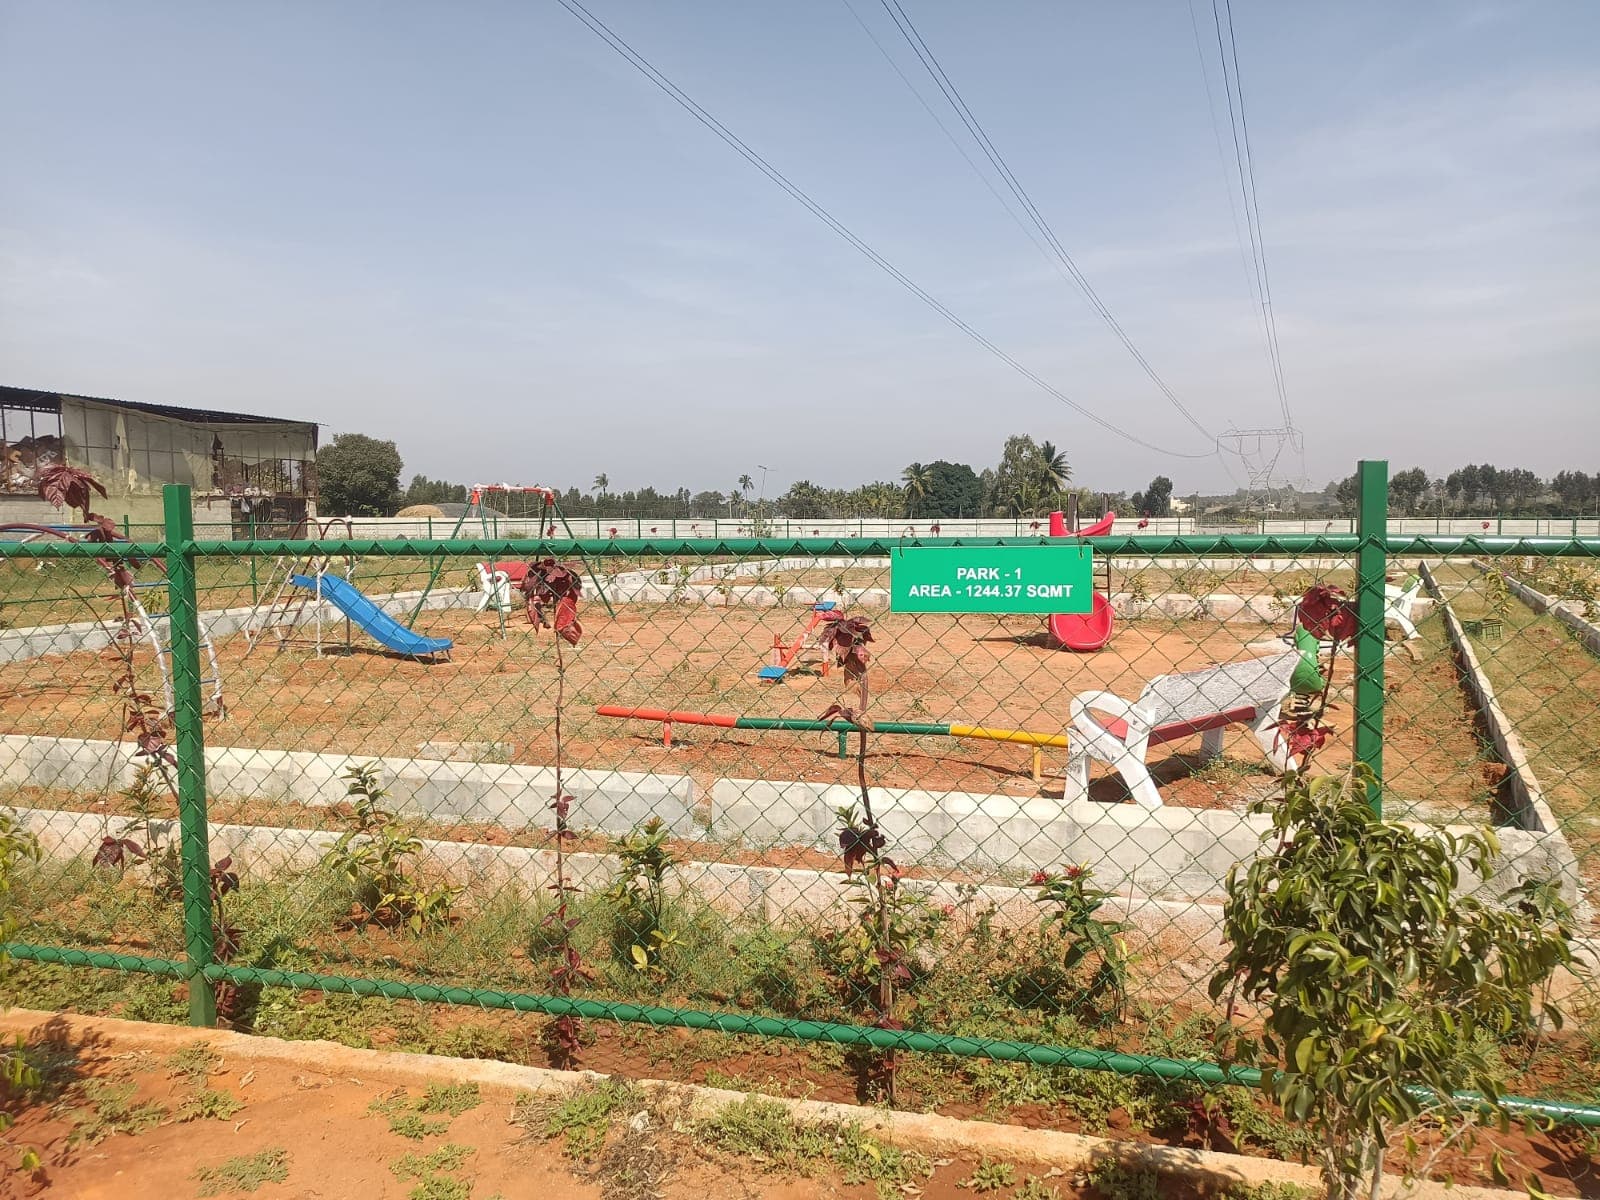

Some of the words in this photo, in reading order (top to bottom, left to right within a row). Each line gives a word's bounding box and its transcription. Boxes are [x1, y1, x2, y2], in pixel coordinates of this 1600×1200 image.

[957, 567, 1000, 580] PARK
[1014, 567, 1022, 580] 1
[908, 584, 952, 597] AREA
[966, 584, 1022, 597] 1244.37
[1026, 584, 1074, 598] SQMT
